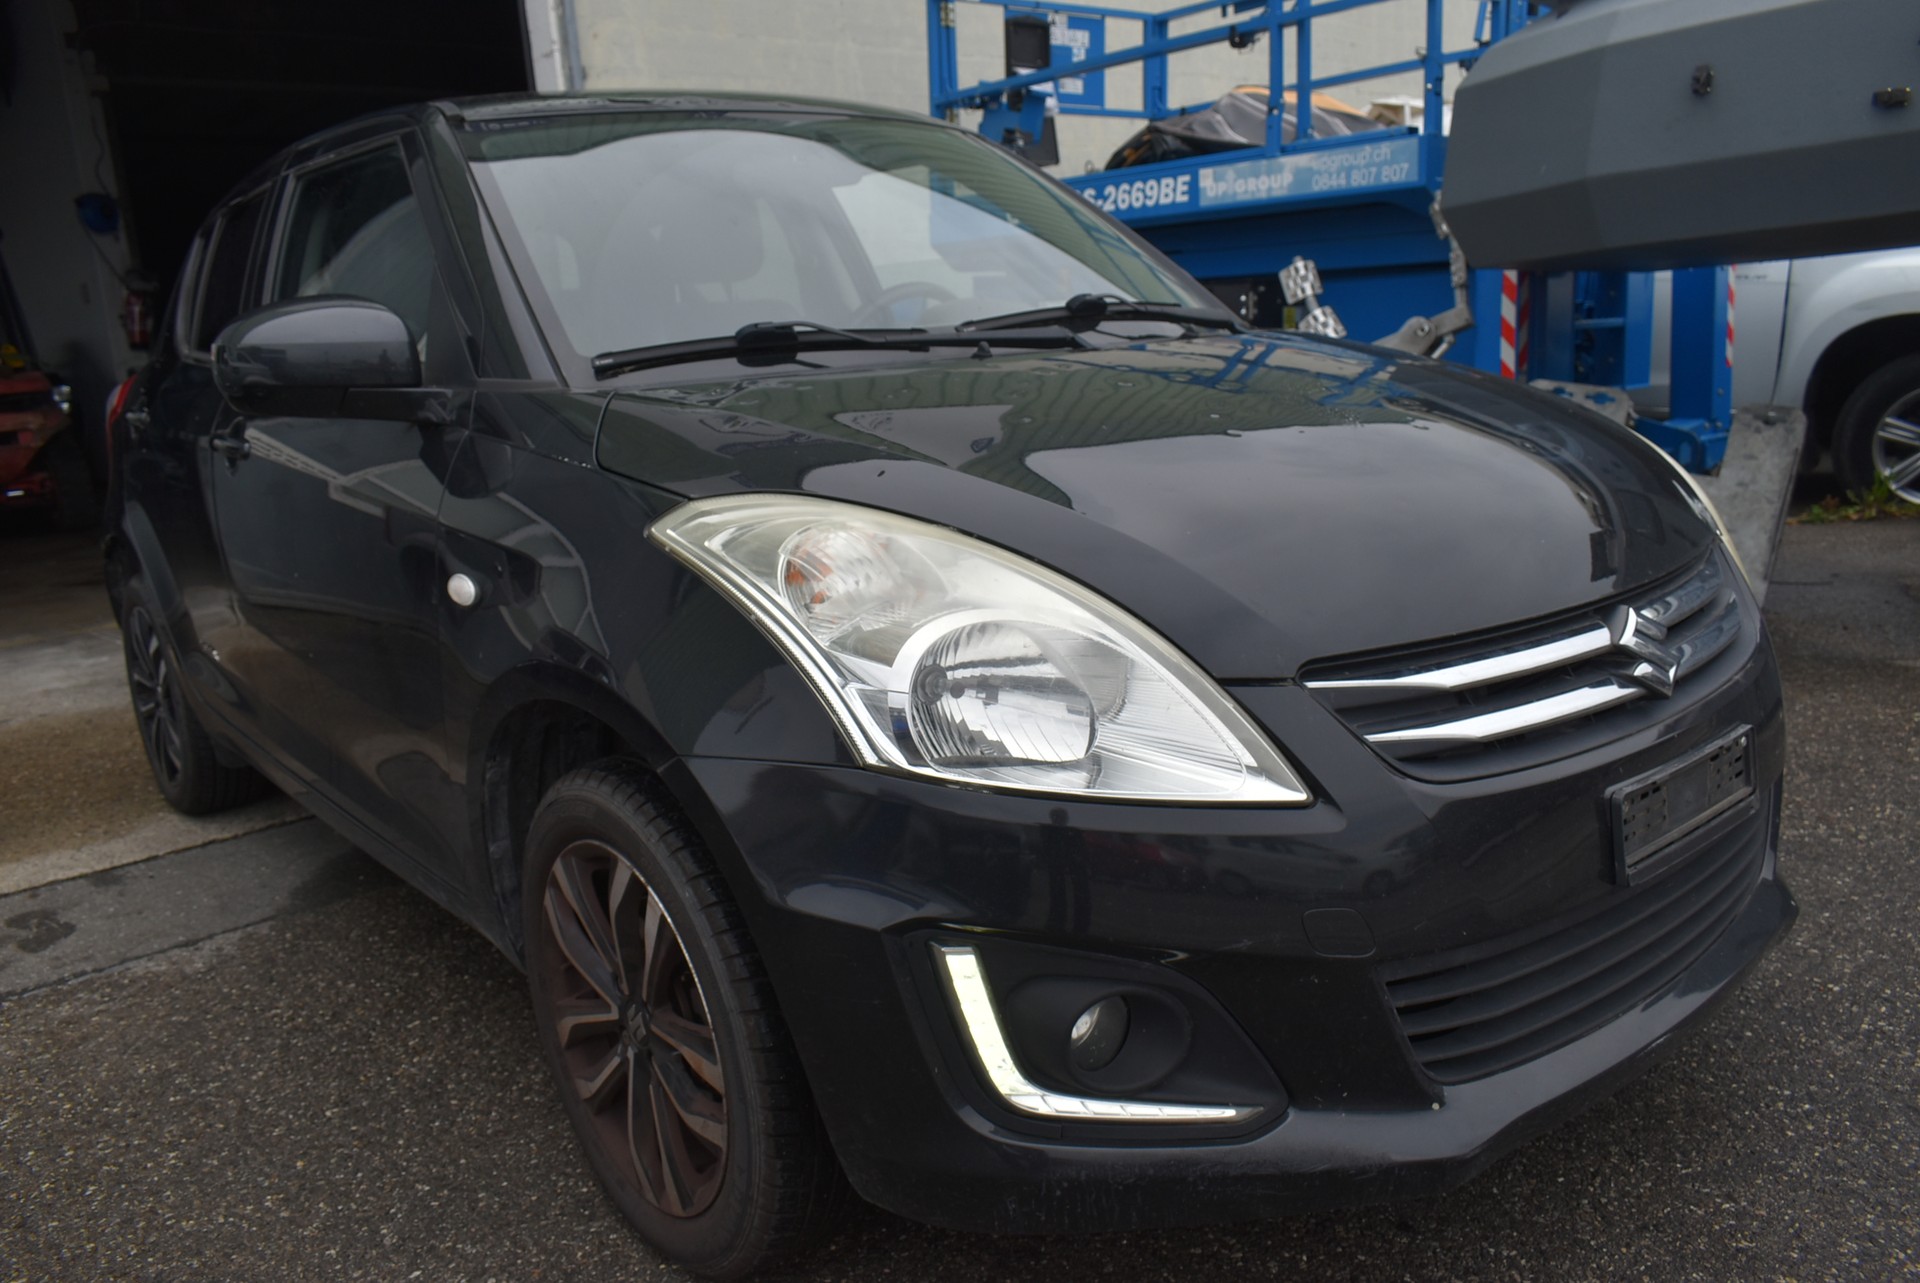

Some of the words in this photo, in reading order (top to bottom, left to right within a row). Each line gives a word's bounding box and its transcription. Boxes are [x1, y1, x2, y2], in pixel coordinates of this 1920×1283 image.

[1075, 173, 1192, 212] S-2669BE
[1311, 171, 1347, 192] 0844
[1351, 166, 1378, 187] 807
[1381, 162, 1410, 184] 807
